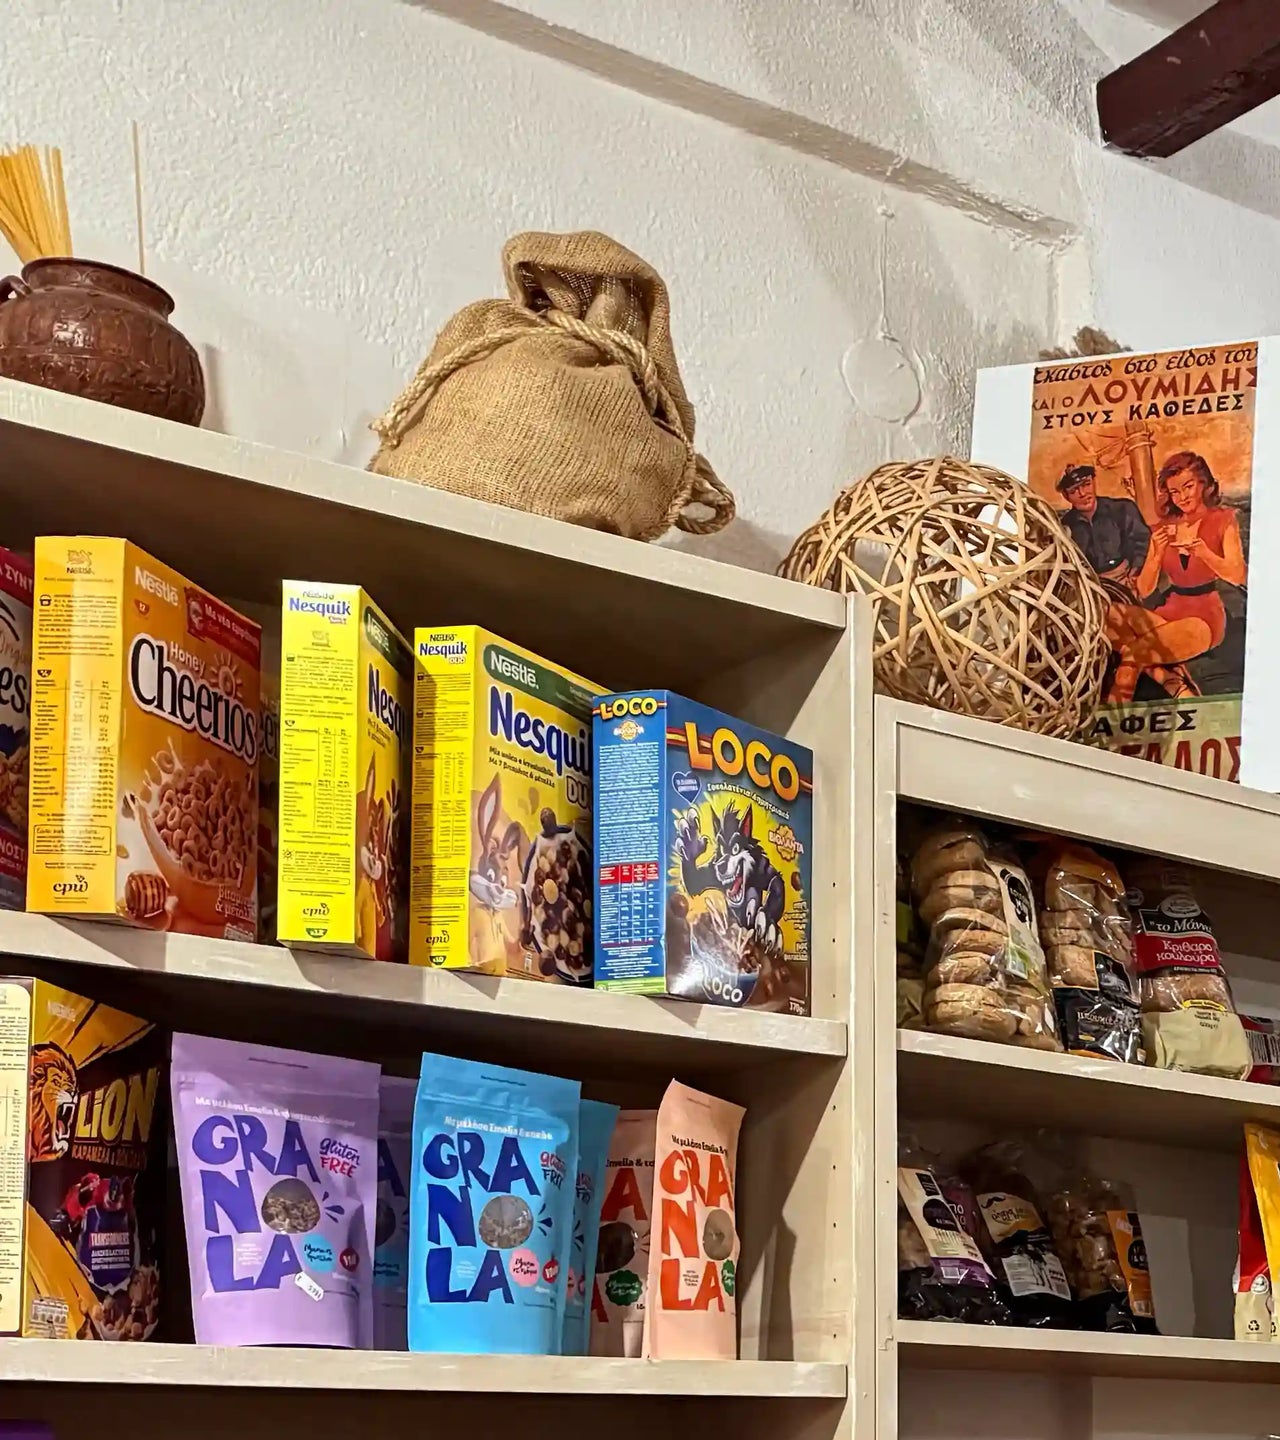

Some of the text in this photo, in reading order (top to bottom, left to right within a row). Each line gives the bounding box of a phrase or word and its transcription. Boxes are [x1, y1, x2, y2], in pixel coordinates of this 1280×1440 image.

[1078, 366, 1258, 407] ΛΟΥΜΙΔΗΣ
[1041, 393, 1245, 431] ΣΤΟΥΣ ΚΑΦΕΔΕΣ
[289, 597, 350, 618] Nesquik
[419, 642, 467, 658] Nesquik
[131, 636, 256, 757] Cheerios
[601, 697, 658, 720] LOCO
[684, 721, 800, 801] LOCO
[321, 1157, 357, 1179] FREE
[206, 1234, 303, 1293] LA
[426, 1247, 515, 1305] LA
[660, 1259, 725, 1312] LA
